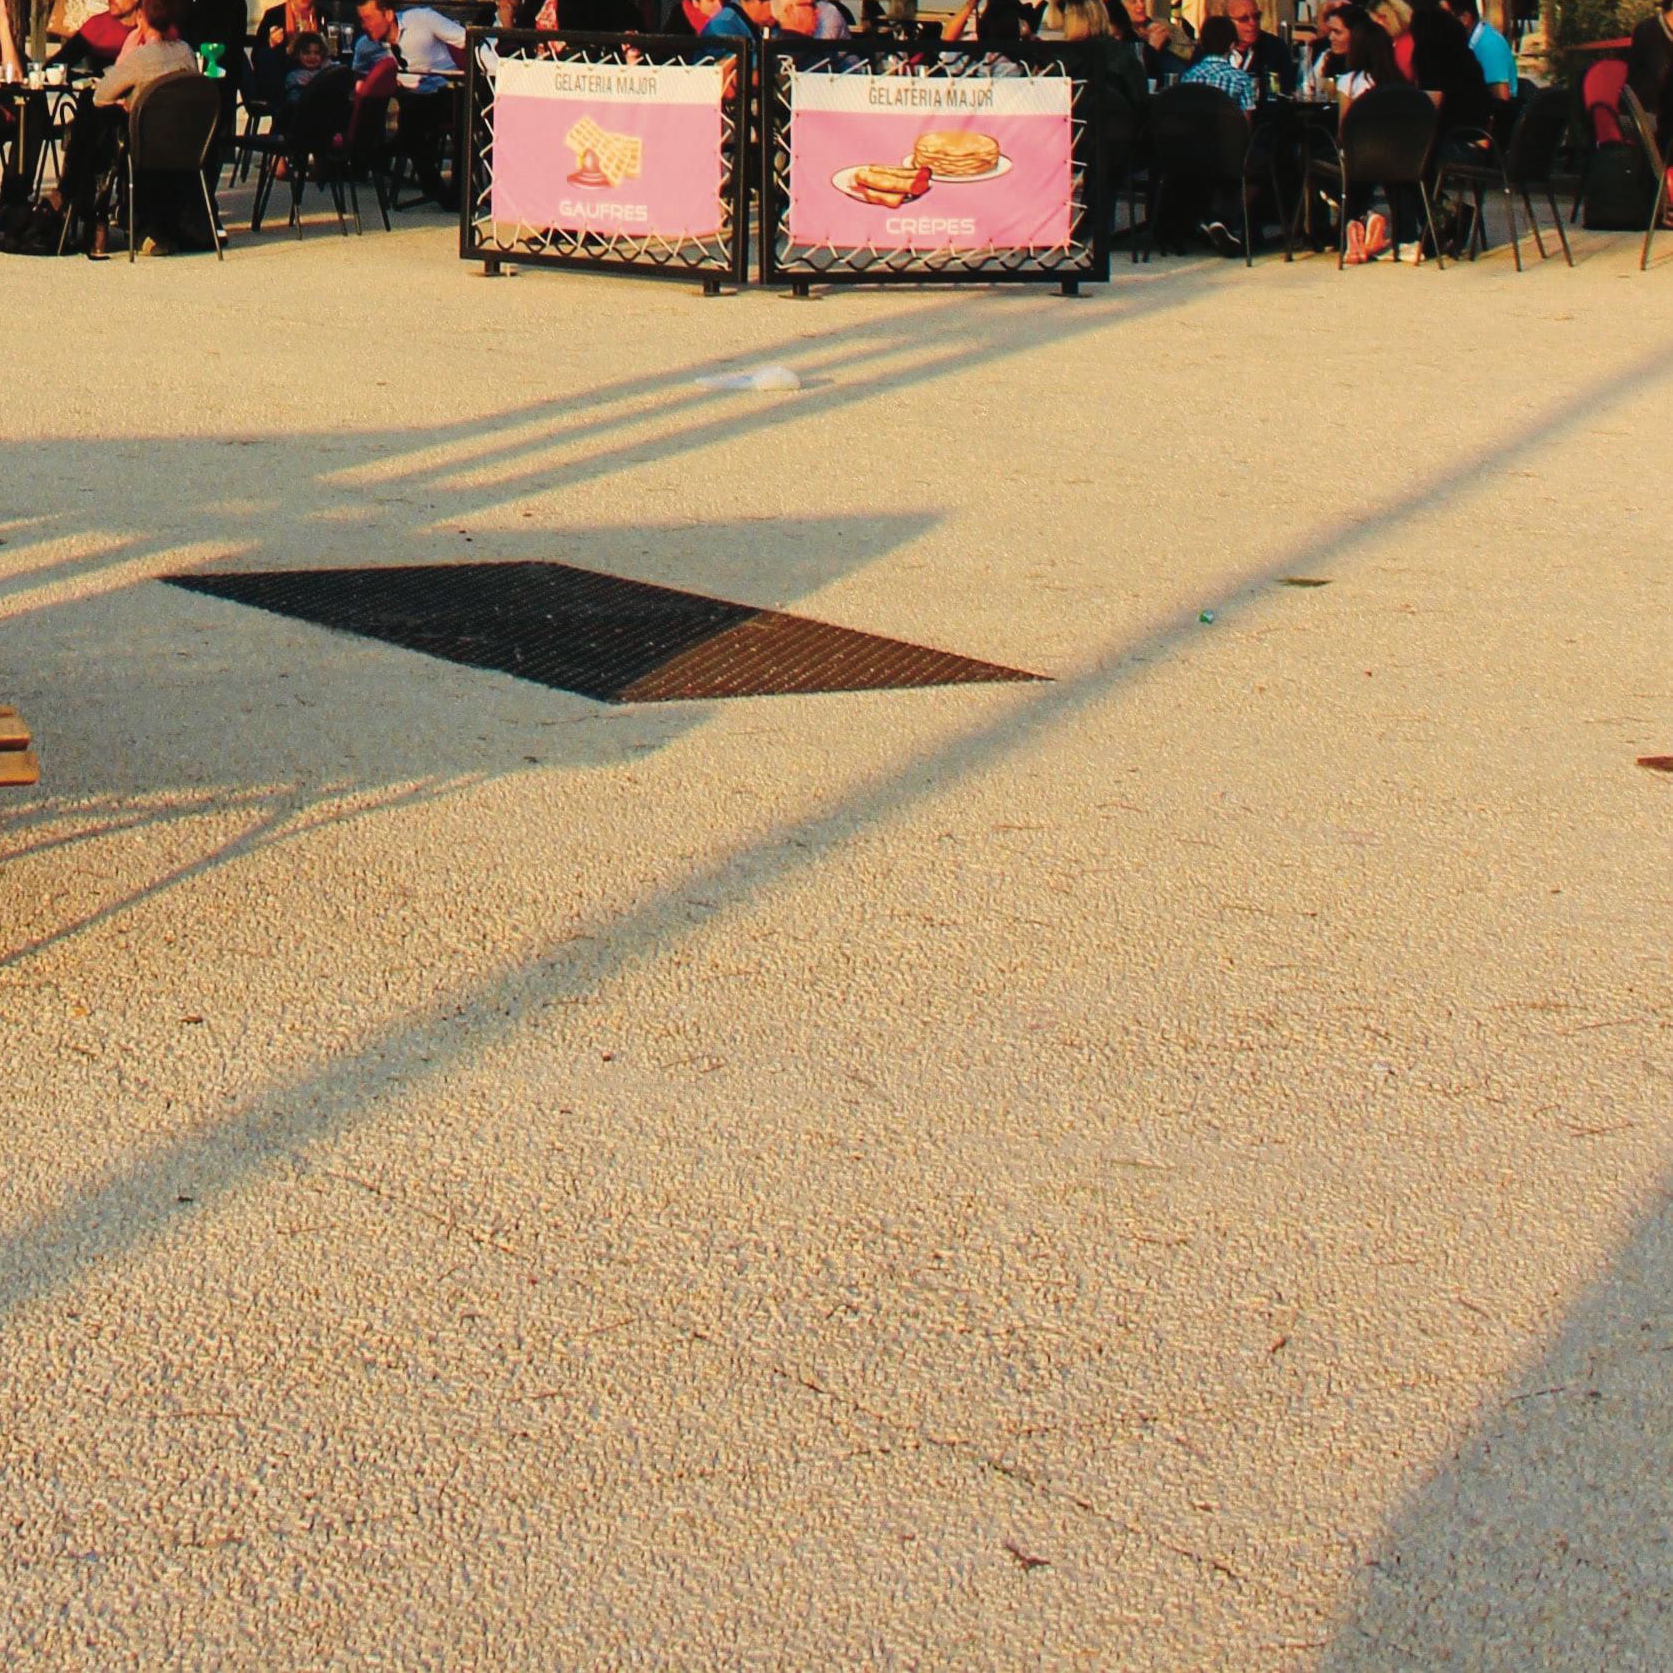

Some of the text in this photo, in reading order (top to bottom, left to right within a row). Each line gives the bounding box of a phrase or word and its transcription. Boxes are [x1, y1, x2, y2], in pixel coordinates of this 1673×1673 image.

[555, 73, 658, 95] GELATERIA MAJOR
[868, 86, 994, 108] GELATERIA MAJOR
[558, 199, 648, 222] GAUFRES
